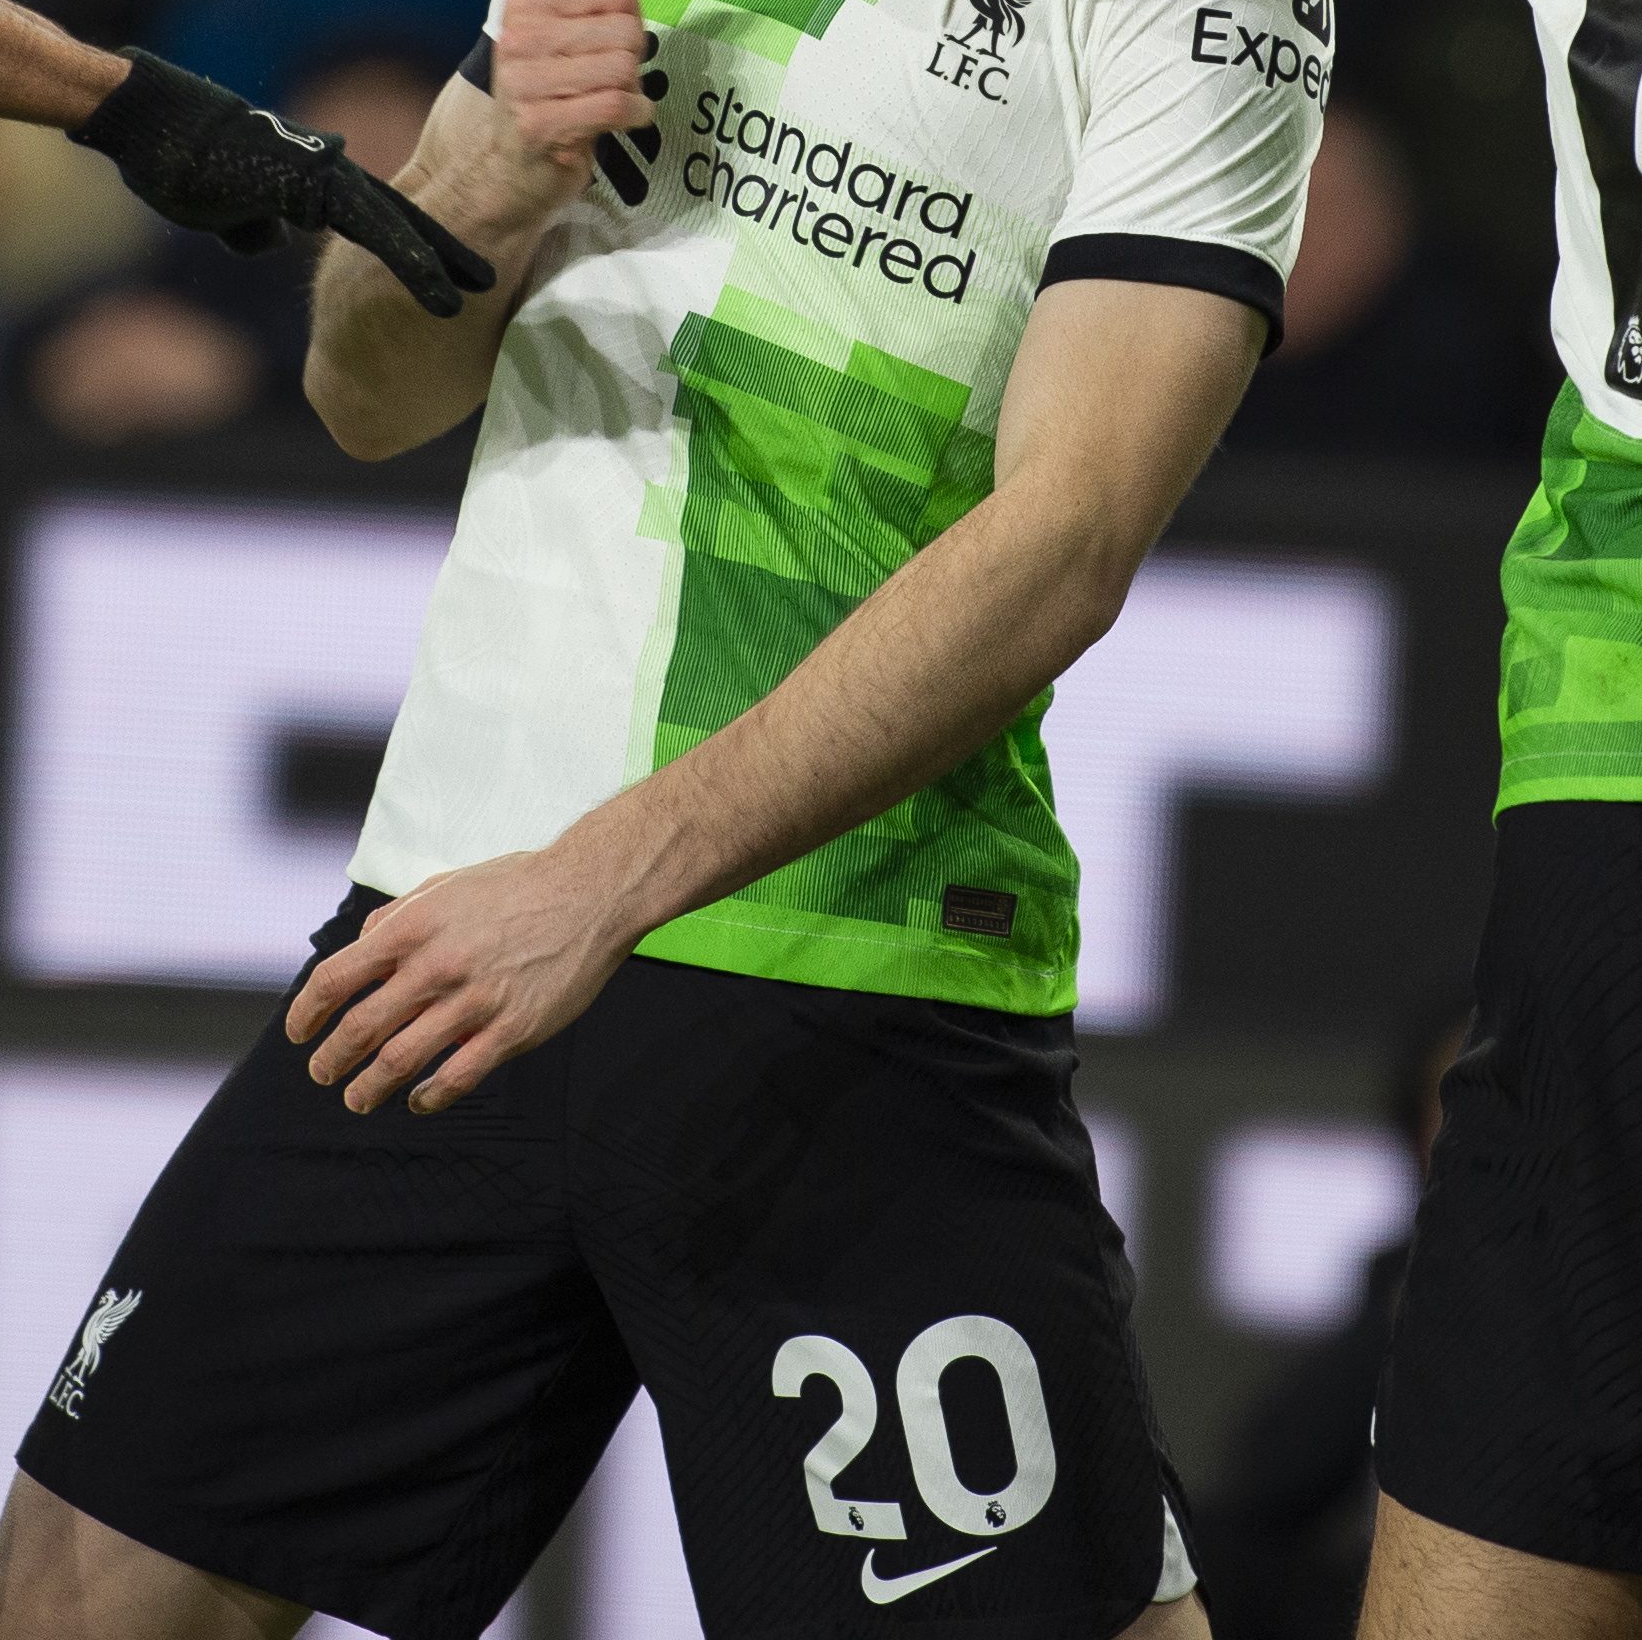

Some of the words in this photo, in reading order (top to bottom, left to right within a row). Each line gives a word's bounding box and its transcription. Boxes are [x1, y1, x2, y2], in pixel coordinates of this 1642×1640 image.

[682, 145, 977, 305] chartered
[690, 86, 974, 240] standard
[771, 1314, 1057, 1541] 20
